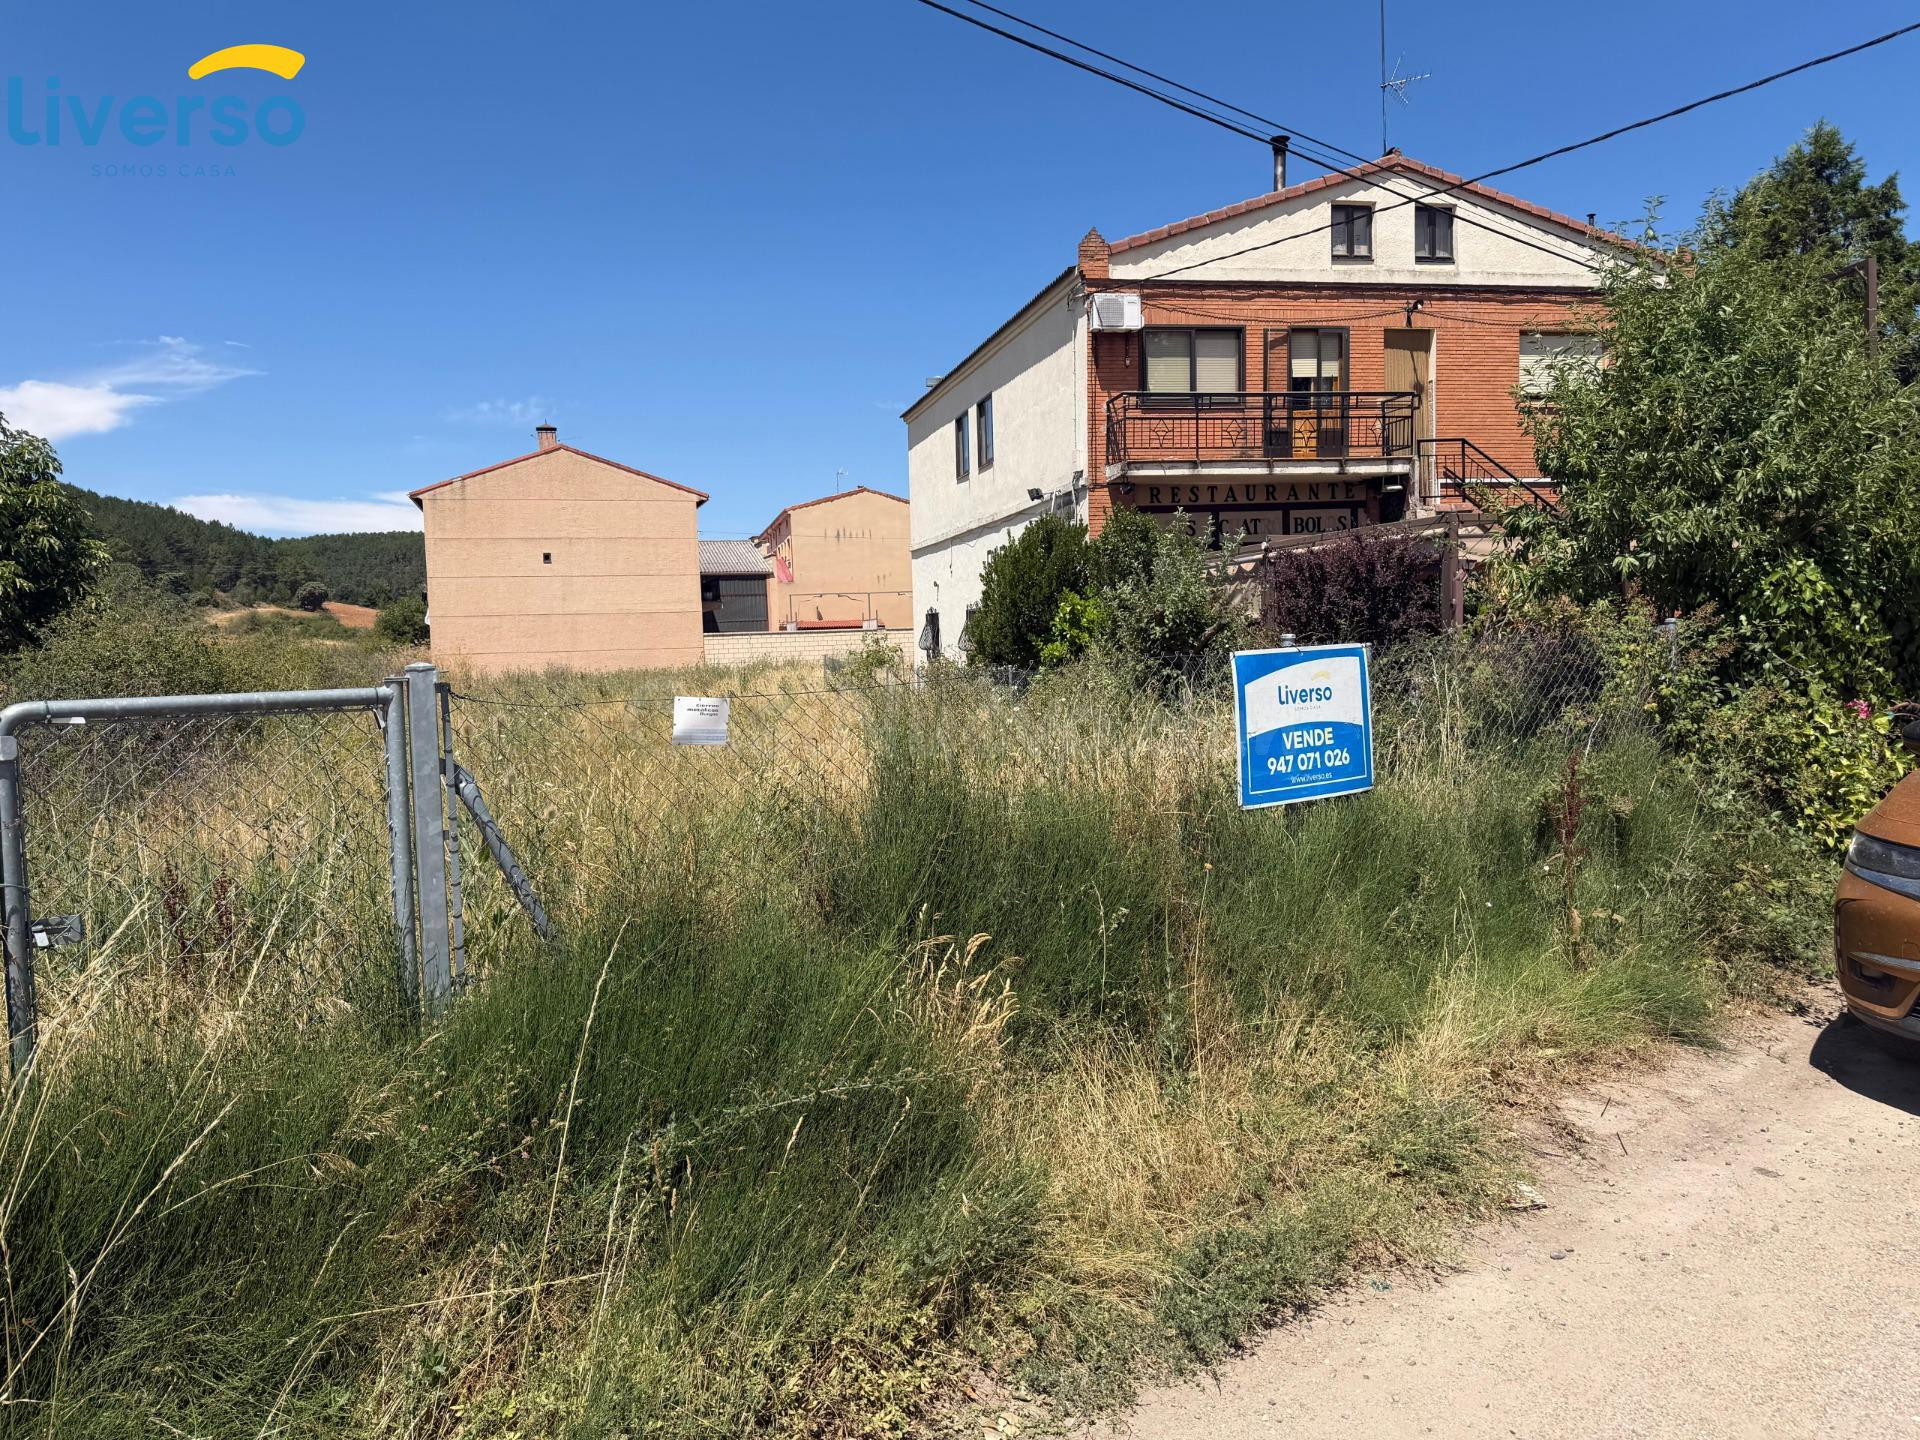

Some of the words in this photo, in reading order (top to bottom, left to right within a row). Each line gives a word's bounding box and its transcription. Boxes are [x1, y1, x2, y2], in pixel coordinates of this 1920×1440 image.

[1149, 482, 1356, 504] RESTAURANTE
[1282, 727, 1334, 750] VENDE
[1267, 754, 1294, 775] 947
[1297, 751, 1321, 771] 071
[1324, 748, 1350, 768] 026
